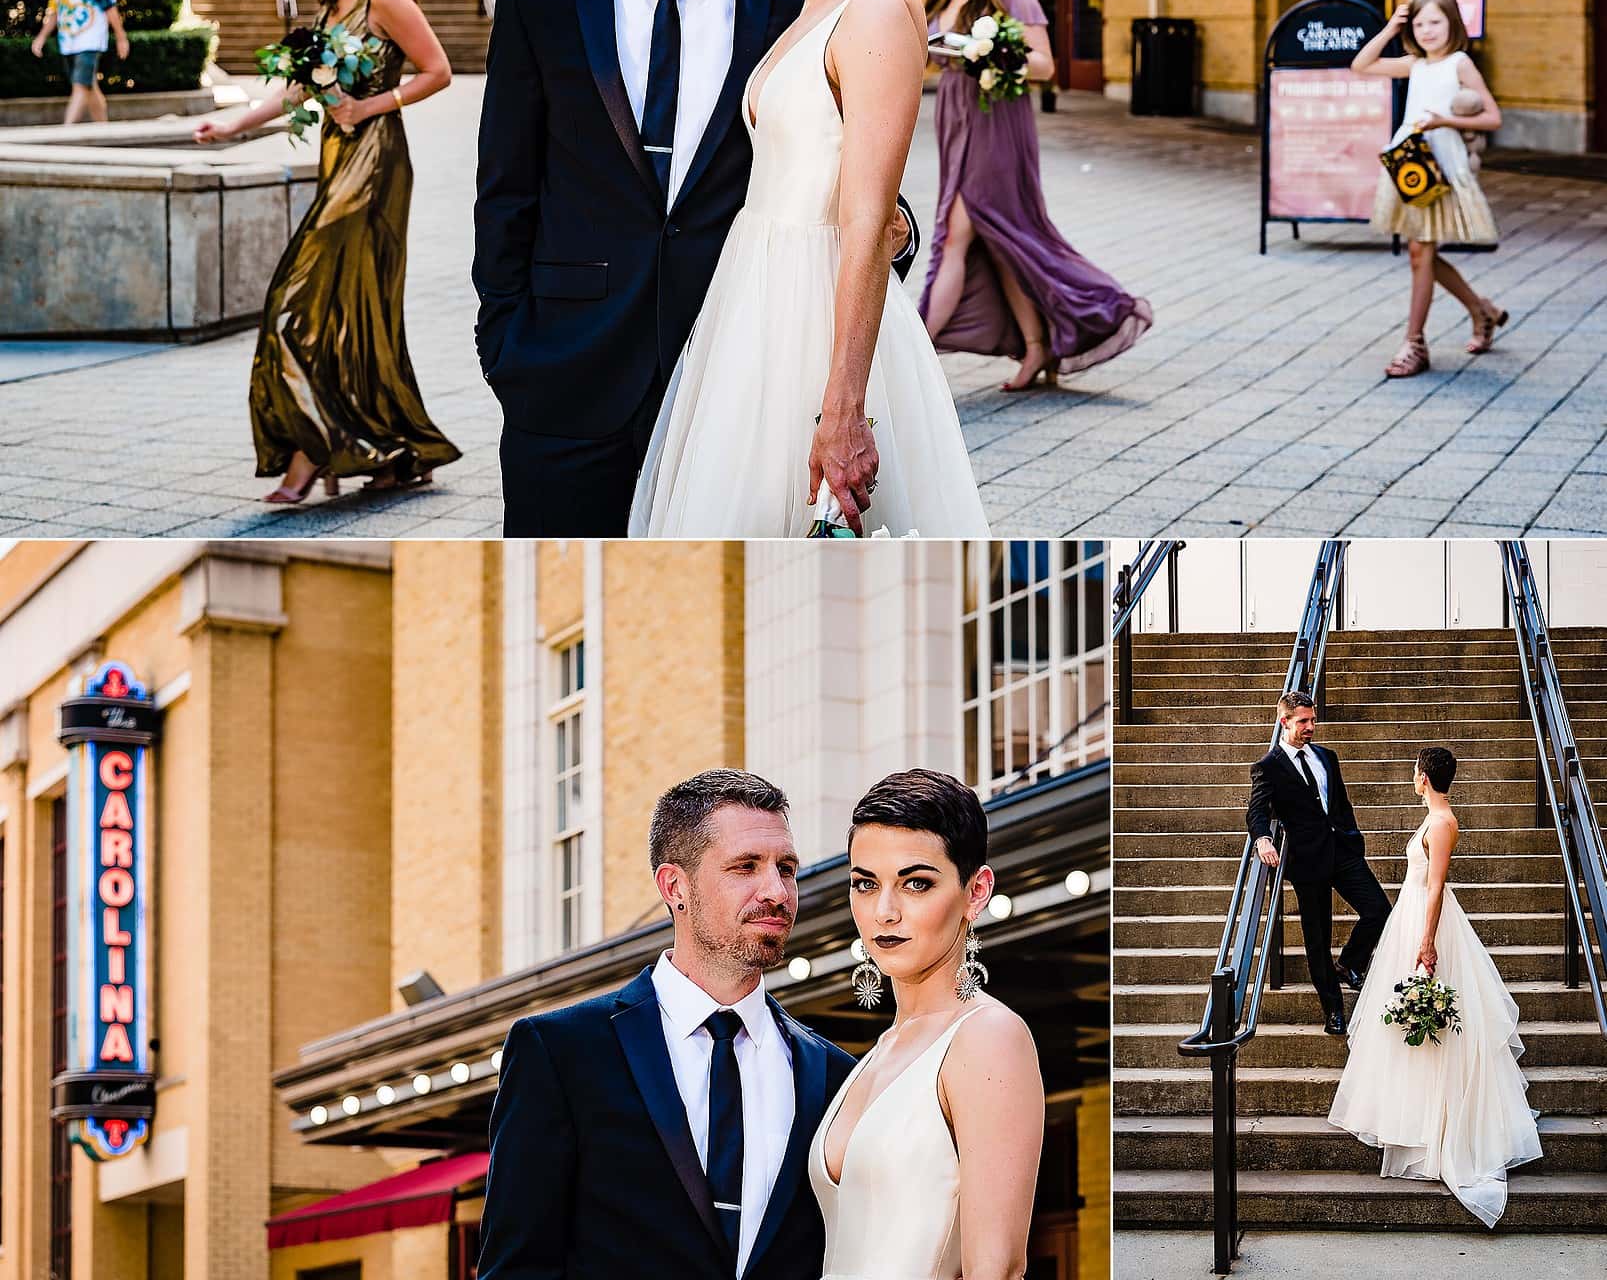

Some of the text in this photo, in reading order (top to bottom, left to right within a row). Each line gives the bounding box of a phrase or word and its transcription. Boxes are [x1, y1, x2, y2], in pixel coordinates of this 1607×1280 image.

[1297, 27, 1365, 41] CAROLINA
[1304, 39, 1360, 51] THEATRE
[99, 751, 135, 1062] CAROLINA
